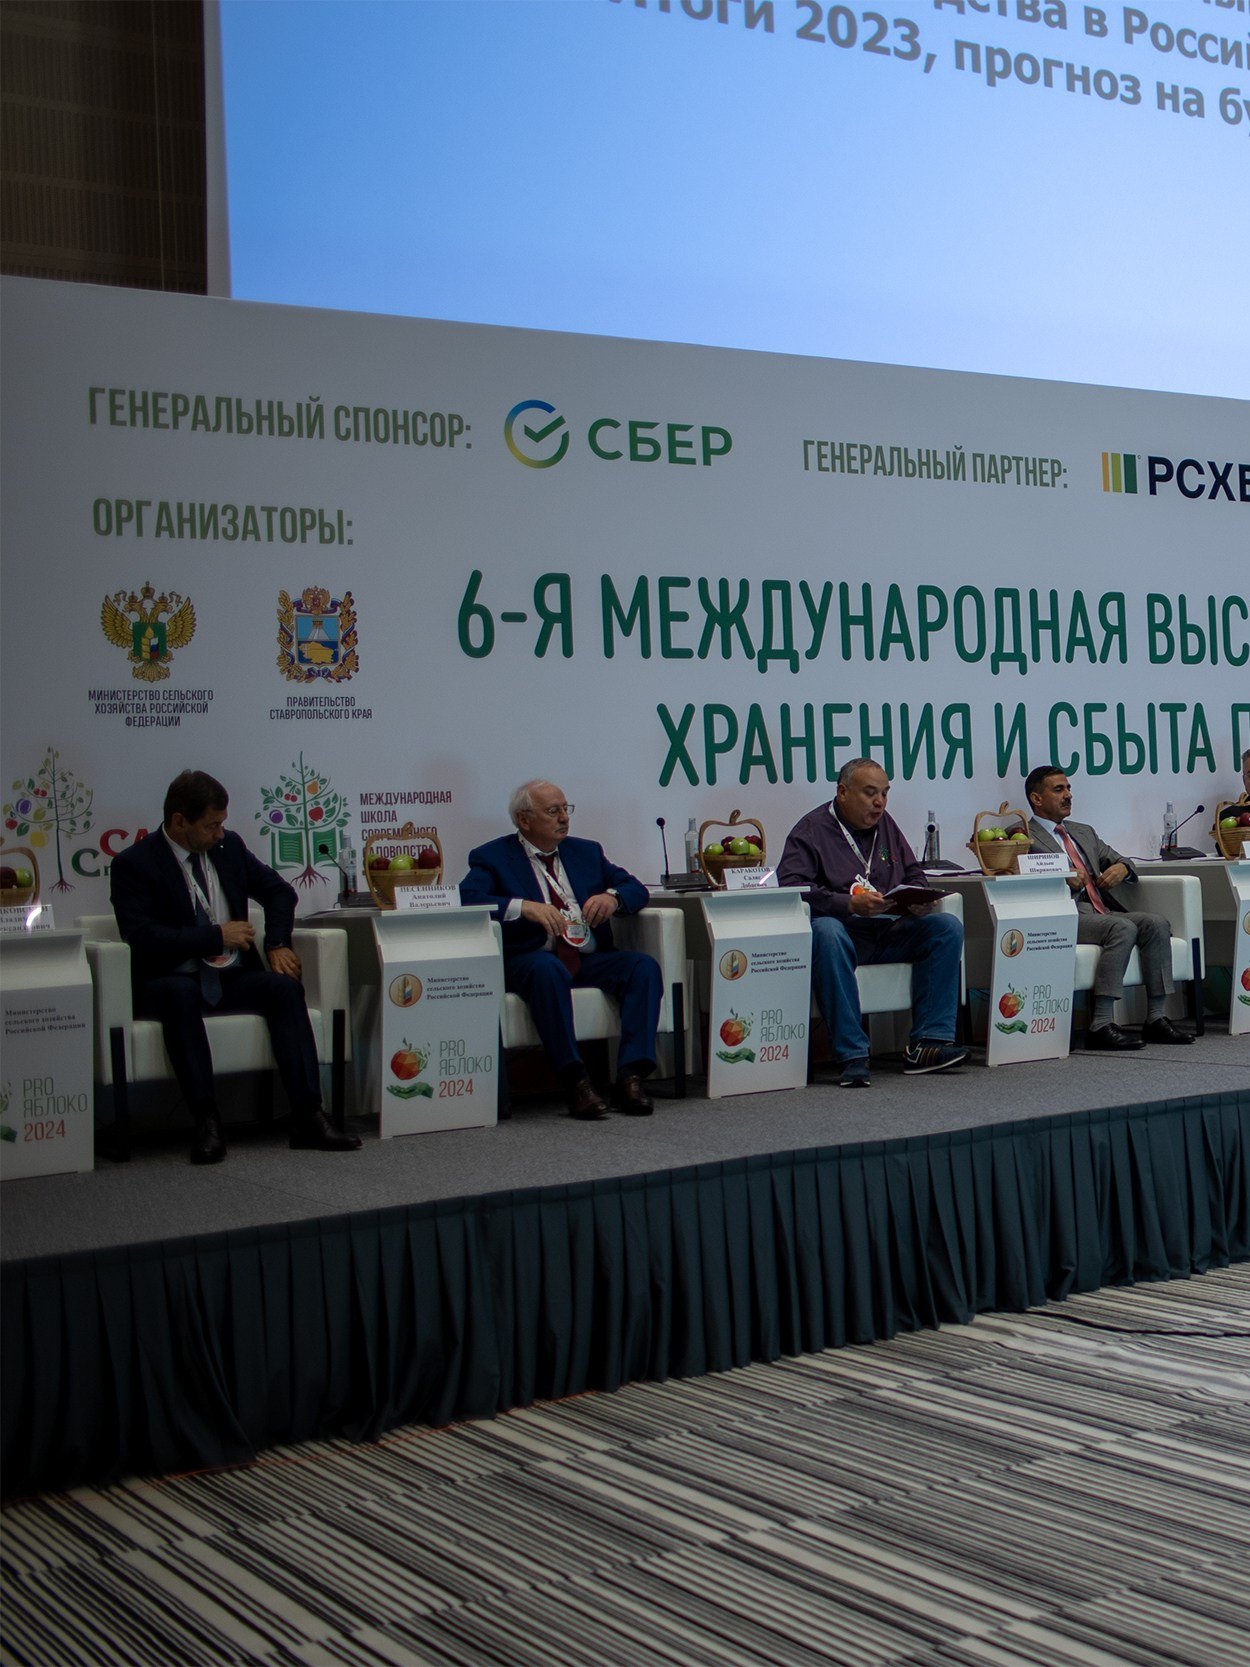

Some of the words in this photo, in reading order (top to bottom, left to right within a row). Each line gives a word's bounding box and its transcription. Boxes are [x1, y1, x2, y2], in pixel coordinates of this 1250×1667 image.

[1084, 5, 1109, 38] в
[796, 5, 937, 73] 2023,
[954, 38, 1142, 105] прогноз
[1156, 81, 1205, 118] на
[88, 386, 325, 440] ГЕНЕРАЛЬНЫЙ
[334, 405, 473, 449] СПОНСОР:
[588, 418, 733, 467] СБЕР
[803, 439, 967, 482] ГЕНЕРАЛЬНЫЙ
[972, 453, 1068, 489] ПАРТНЕР:
[93, 498, 354, 545] ОРГАНИЗАТОРЫ:
[458, 569, 573, 659] 6-Я
[600, 574, 1128, 676] МЕЖДУНАРОДНАЯ
[88, 690, 160, 701] МИНИСТЕРСТВО
[162, 690, 214, 701] СЕЛЬСКОГО
[287, 696, 356, 707] ПРАВИТЕЛЬСТВО
[95, 702, 147, 714] ХОЗЯЙСТВА
[150, 701, 209, 714] РОССИЙСКОЙ
[270, 709, 350, 720] СТАВРОПОЛЬСКОГО
[352, 709, 373, 719] КРАЯ
[125, 716, 181, 728] ФЕДЕРАЦИИ
[657, 702, 974, 787] ХРАНЕНИЯ
[994, 702, 1028, 779] И
[1049, 701, 1217, 776] СБЫТА
[360, 791, 452, 806] МЕЖДУНАРОДНАЯ
[361, 810, 398, 823] ШКОЛА
[1032, 984, 1052, 1000] PRO
[1032, 998, 1070, 1016] ЯБЛОКО
[761, 1009, 783, 1027] PRO
[1030, 1017, 1056, 1034] 2024
[760, 1022, 806, 1043] ЯБЛОКО
[439, 1039, 466, 1058] PRO
[760, 1044, 790, 1063] 2024
[439, 1055, 493, 1076] ЯБЛОКО
[23, 1076, 54, 1098] PRO
[439, 1078, 474, 1098] 2024
[23, 1093, 88, 1118] ЯБЛОКО
[24, 1119, 66, 1142] 2024
